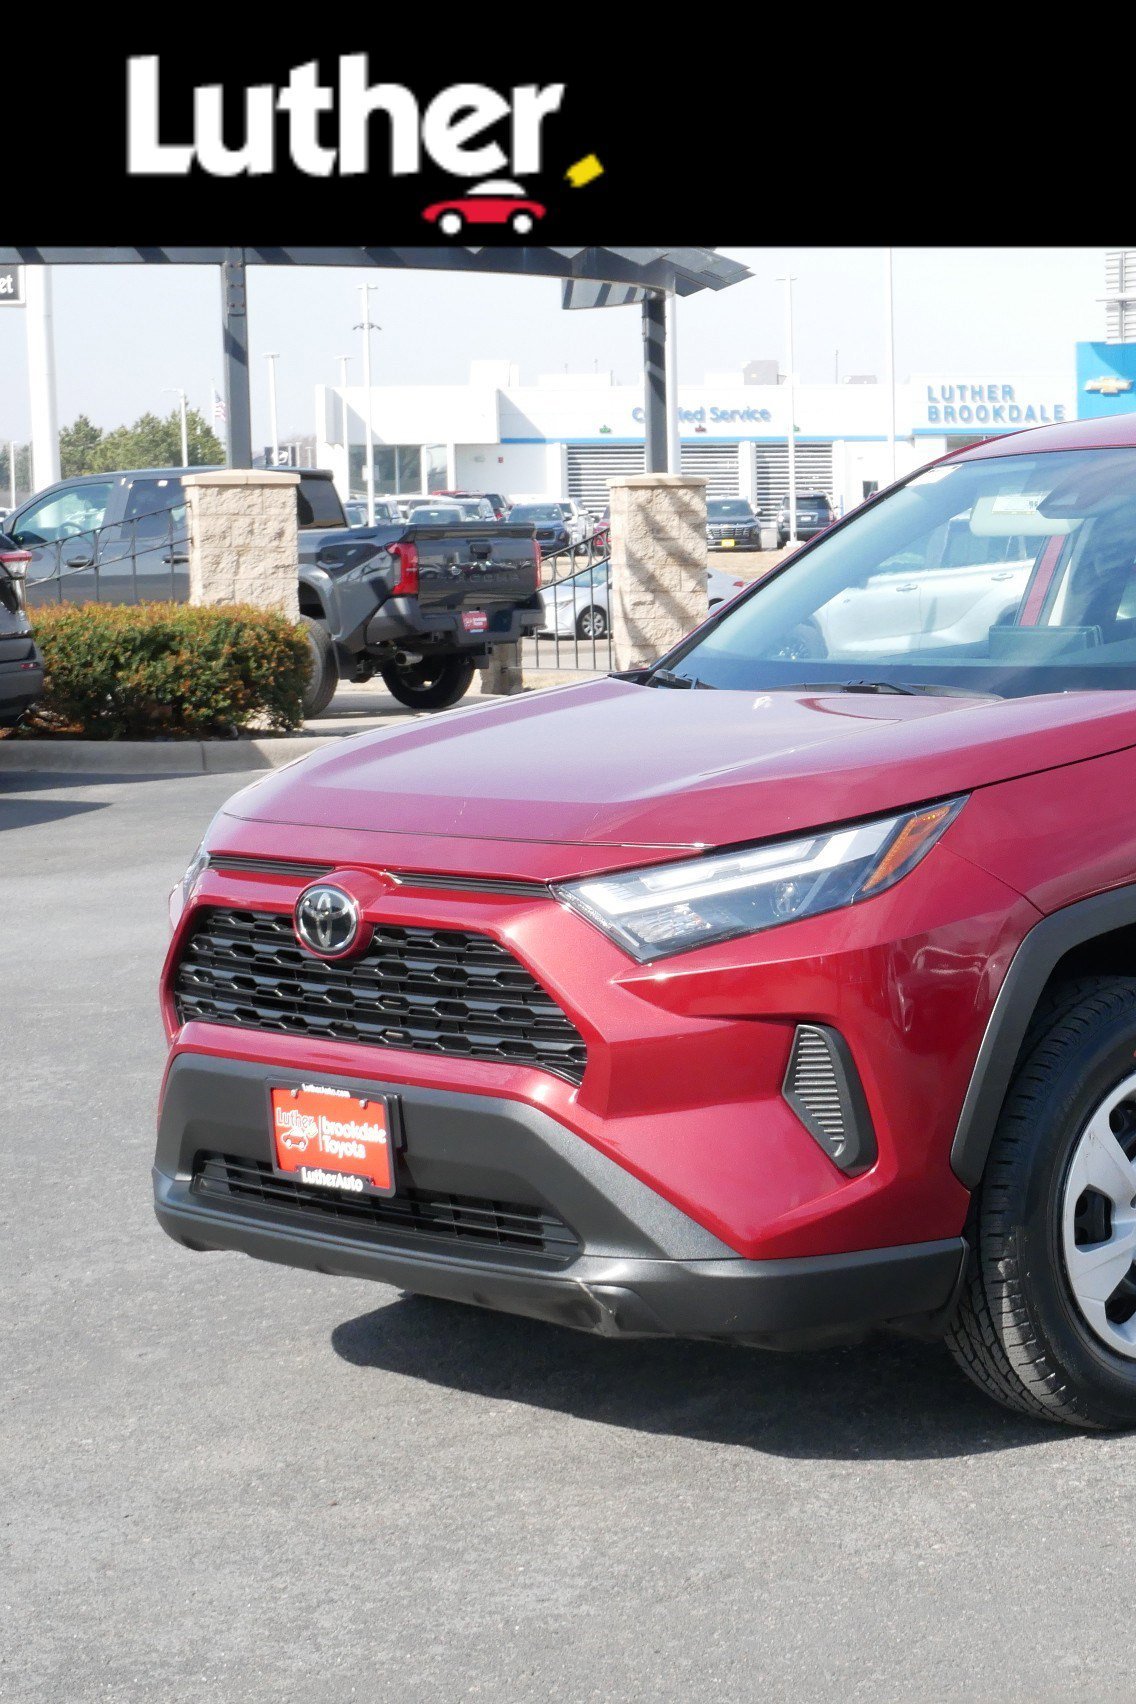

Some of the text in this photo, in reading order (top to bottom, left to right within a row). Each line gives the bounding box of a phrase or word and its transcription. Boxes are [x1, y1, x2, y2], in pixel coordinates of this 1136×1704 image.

[927, 384, 1016, 402] LUTHER
[709, 406, 772, 423] Service
[927, 404, 1066, 423] BROOKDALE
[322, 1134, 367, 1159] Toyota
[301, 1166, 364, 1193] LutherAuto
